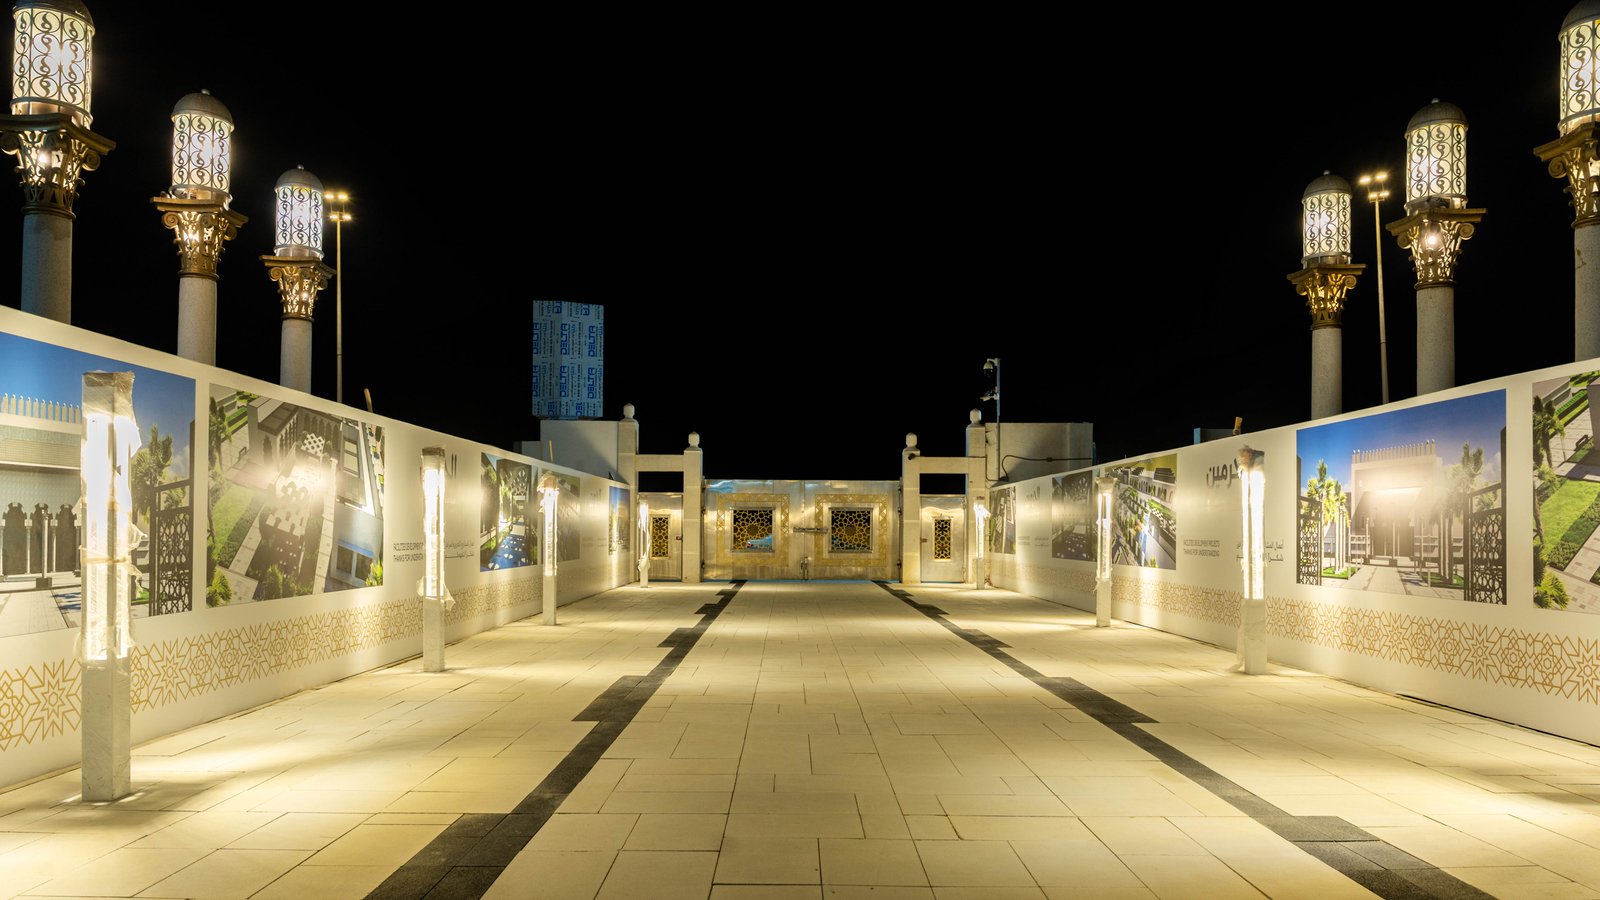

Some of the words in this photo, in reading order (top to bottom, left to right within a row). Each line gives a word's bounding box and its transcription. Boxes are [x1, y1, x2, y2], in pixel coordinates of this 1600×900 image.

[560, 323, 568, 355] DELTA
[560, 365, 568, 398] DELTA
[587, 367, 595, 399] DELTA
